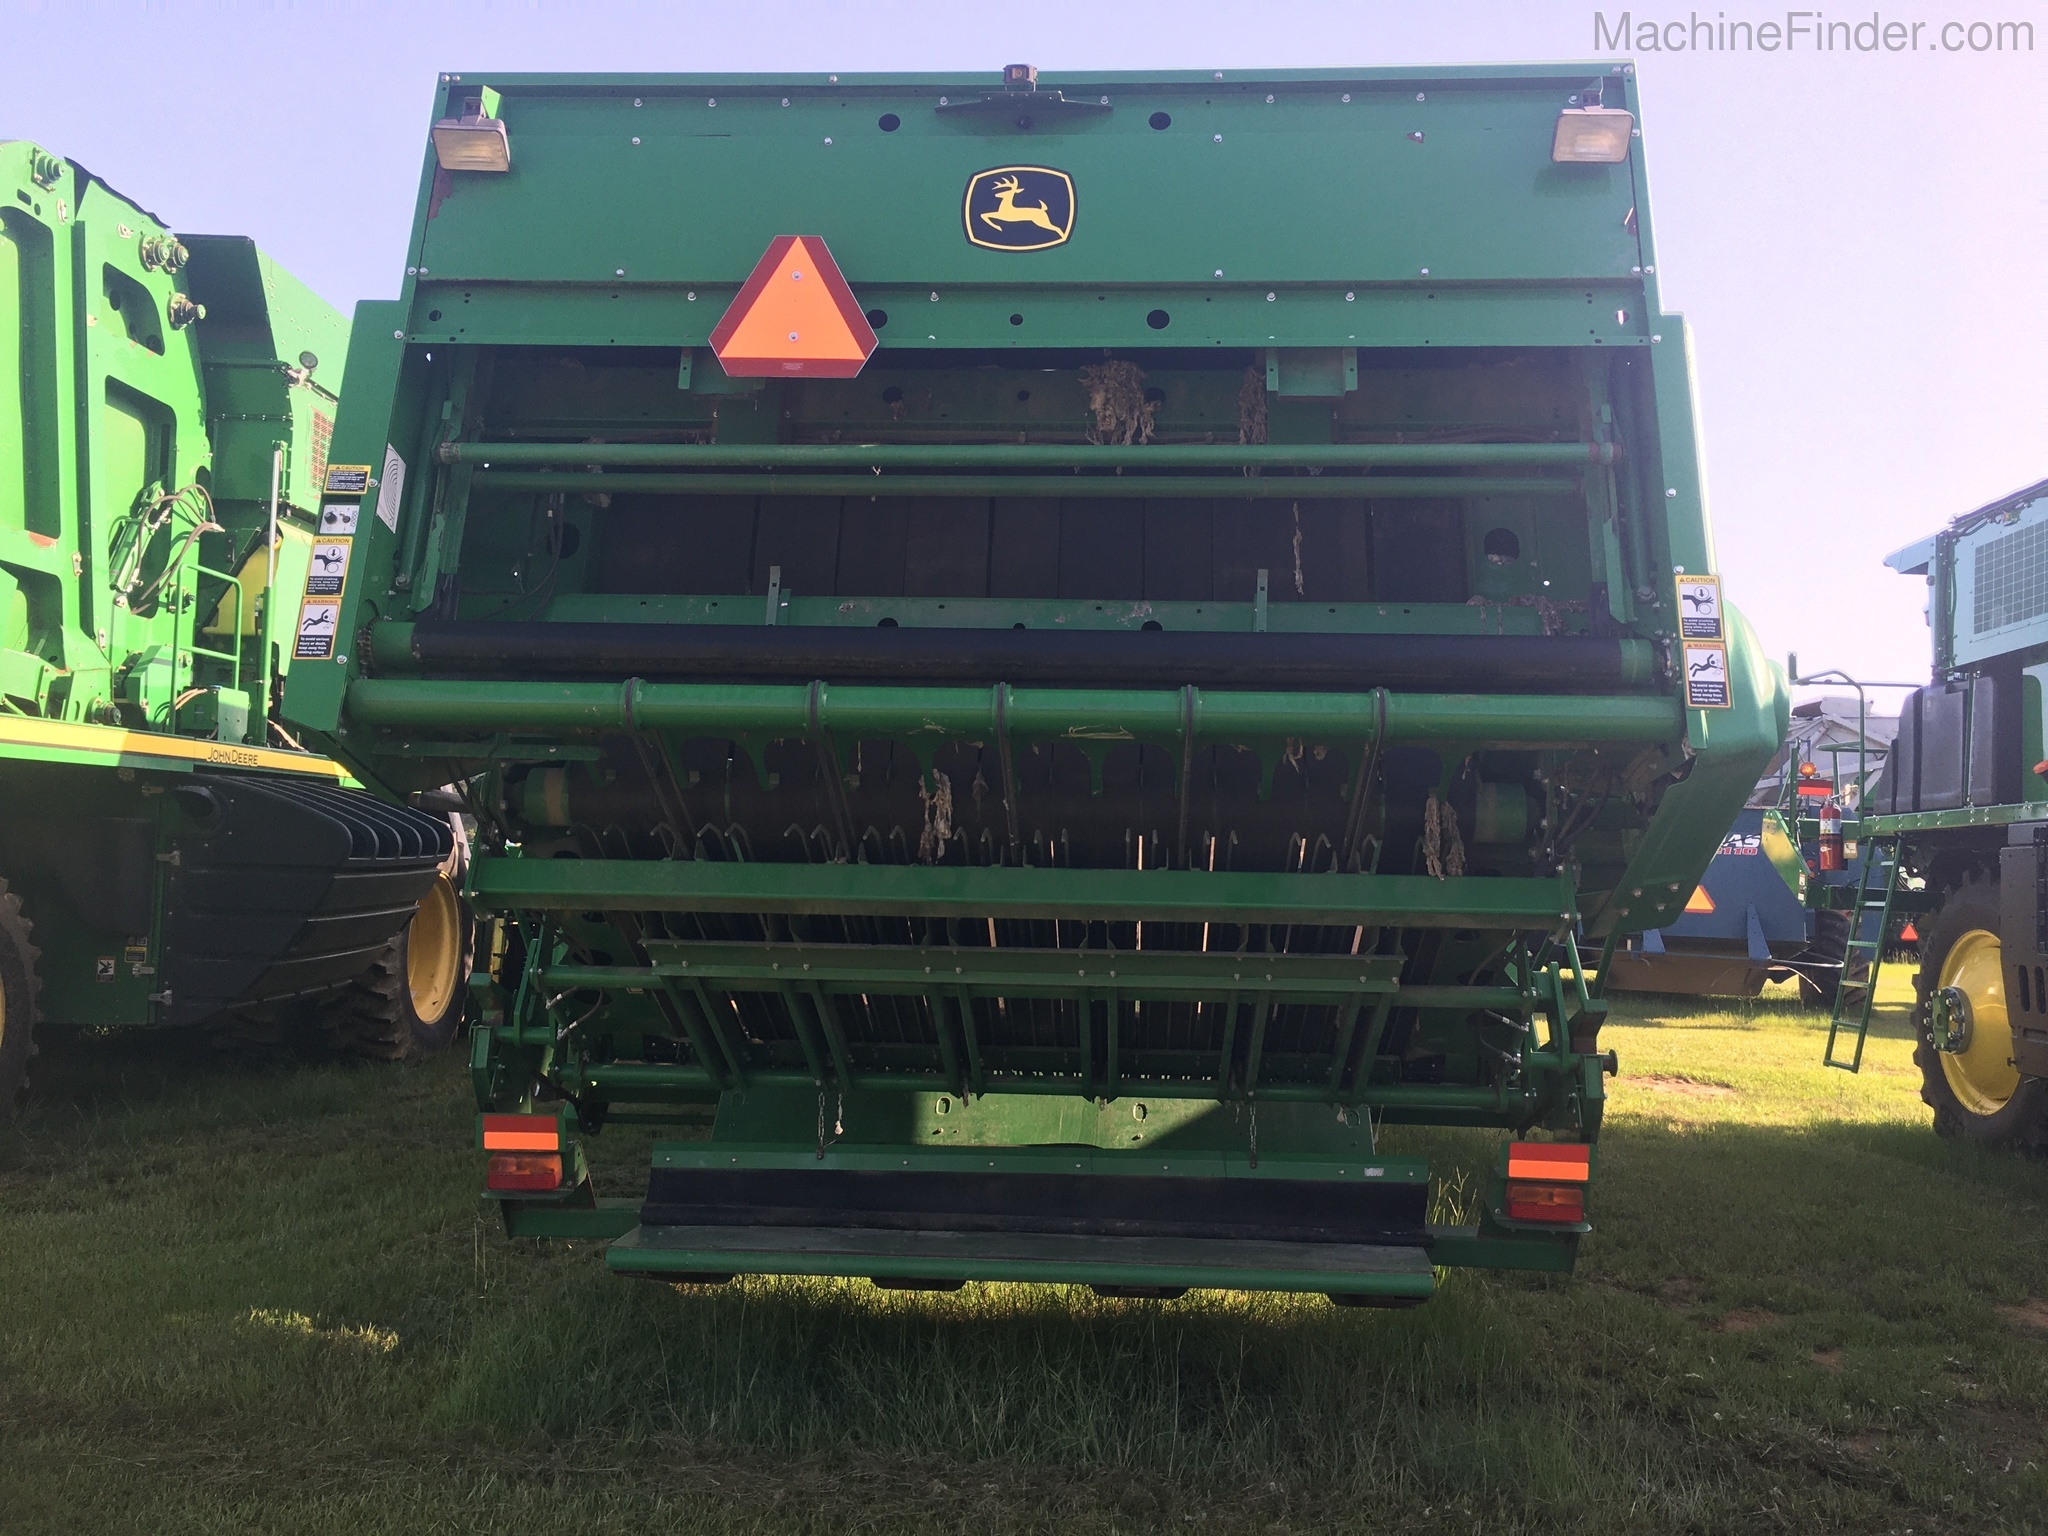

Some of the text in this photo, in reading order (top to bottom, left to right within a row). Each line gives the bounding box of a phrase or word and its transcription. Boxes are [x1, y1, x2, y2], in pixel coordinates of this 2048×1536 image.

[208, 747, 258, 765] JOHN DEERE
[1721, 834, 1761, 847] AS
